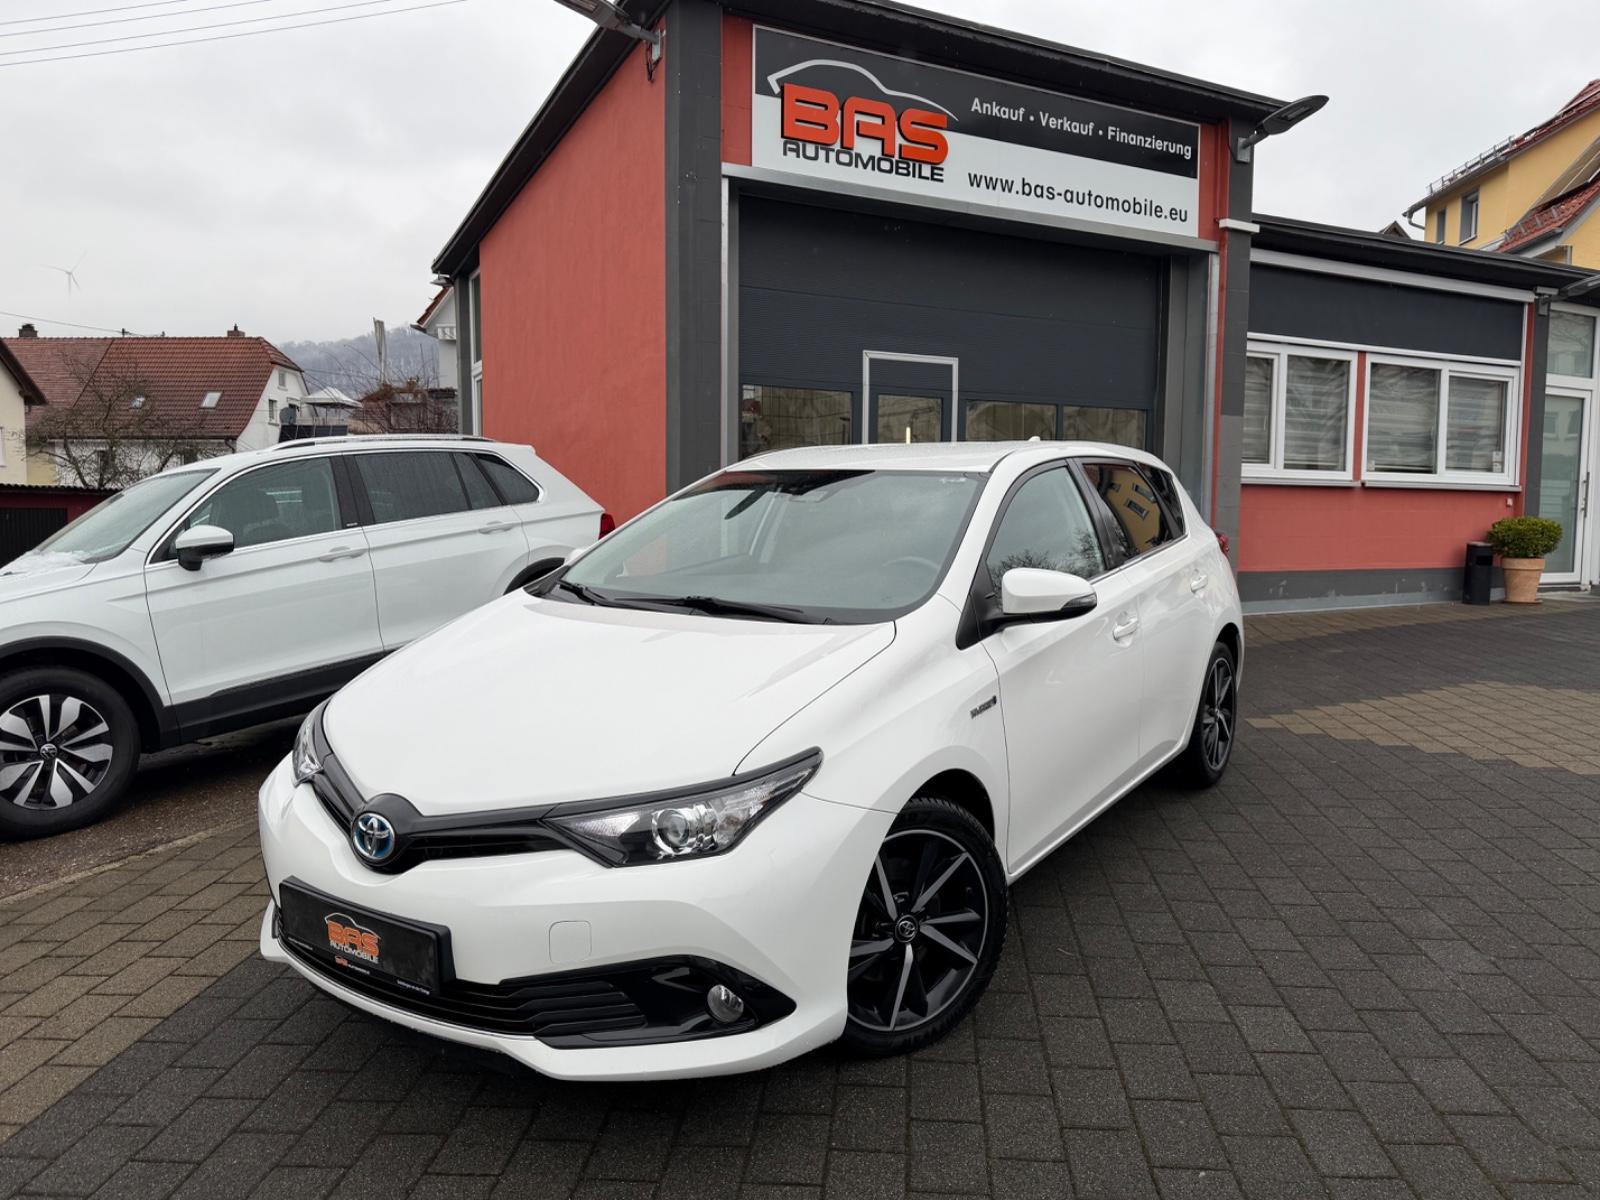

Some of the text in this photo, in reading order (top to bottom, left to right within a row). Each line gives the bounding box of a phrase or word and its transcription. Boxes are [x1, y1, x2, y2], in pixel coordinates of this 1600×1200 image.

[781, 82, 949, 165] BAS
[971, 97, 1192, 160] Ankauf Verkauf Finanzierung
[783, 140, 945, 183] AUTOMOBILE
[967, 171, 1189, 223] www.bas-automobile.eu
[327, 920, 380, 957] BAS
